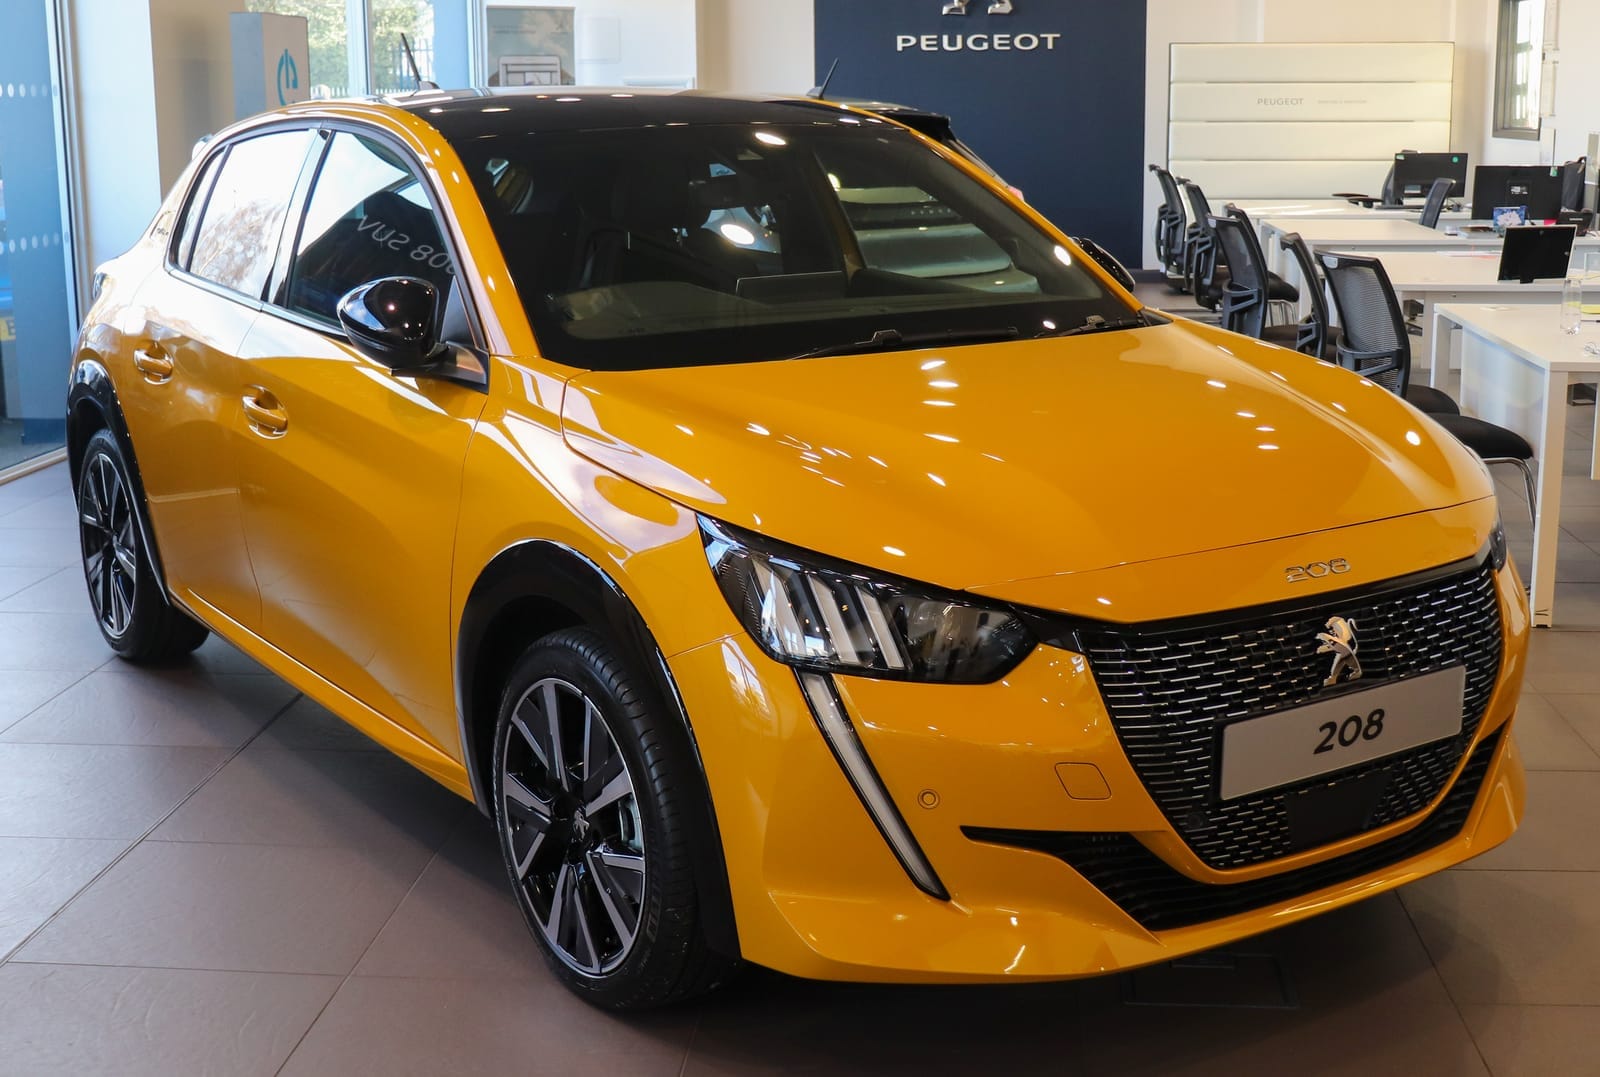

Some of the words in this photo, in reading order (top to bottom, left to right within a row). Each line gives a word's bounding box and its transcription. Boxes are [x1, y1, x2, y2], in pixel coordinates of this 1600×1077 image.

[896, 33, 1061, 51] PEUGEOT
[1257, 97, 1304, 106] PEUGEOT
[1285, 558, 1351, 583] 208
[1313, 708, 1385, 755] 208
